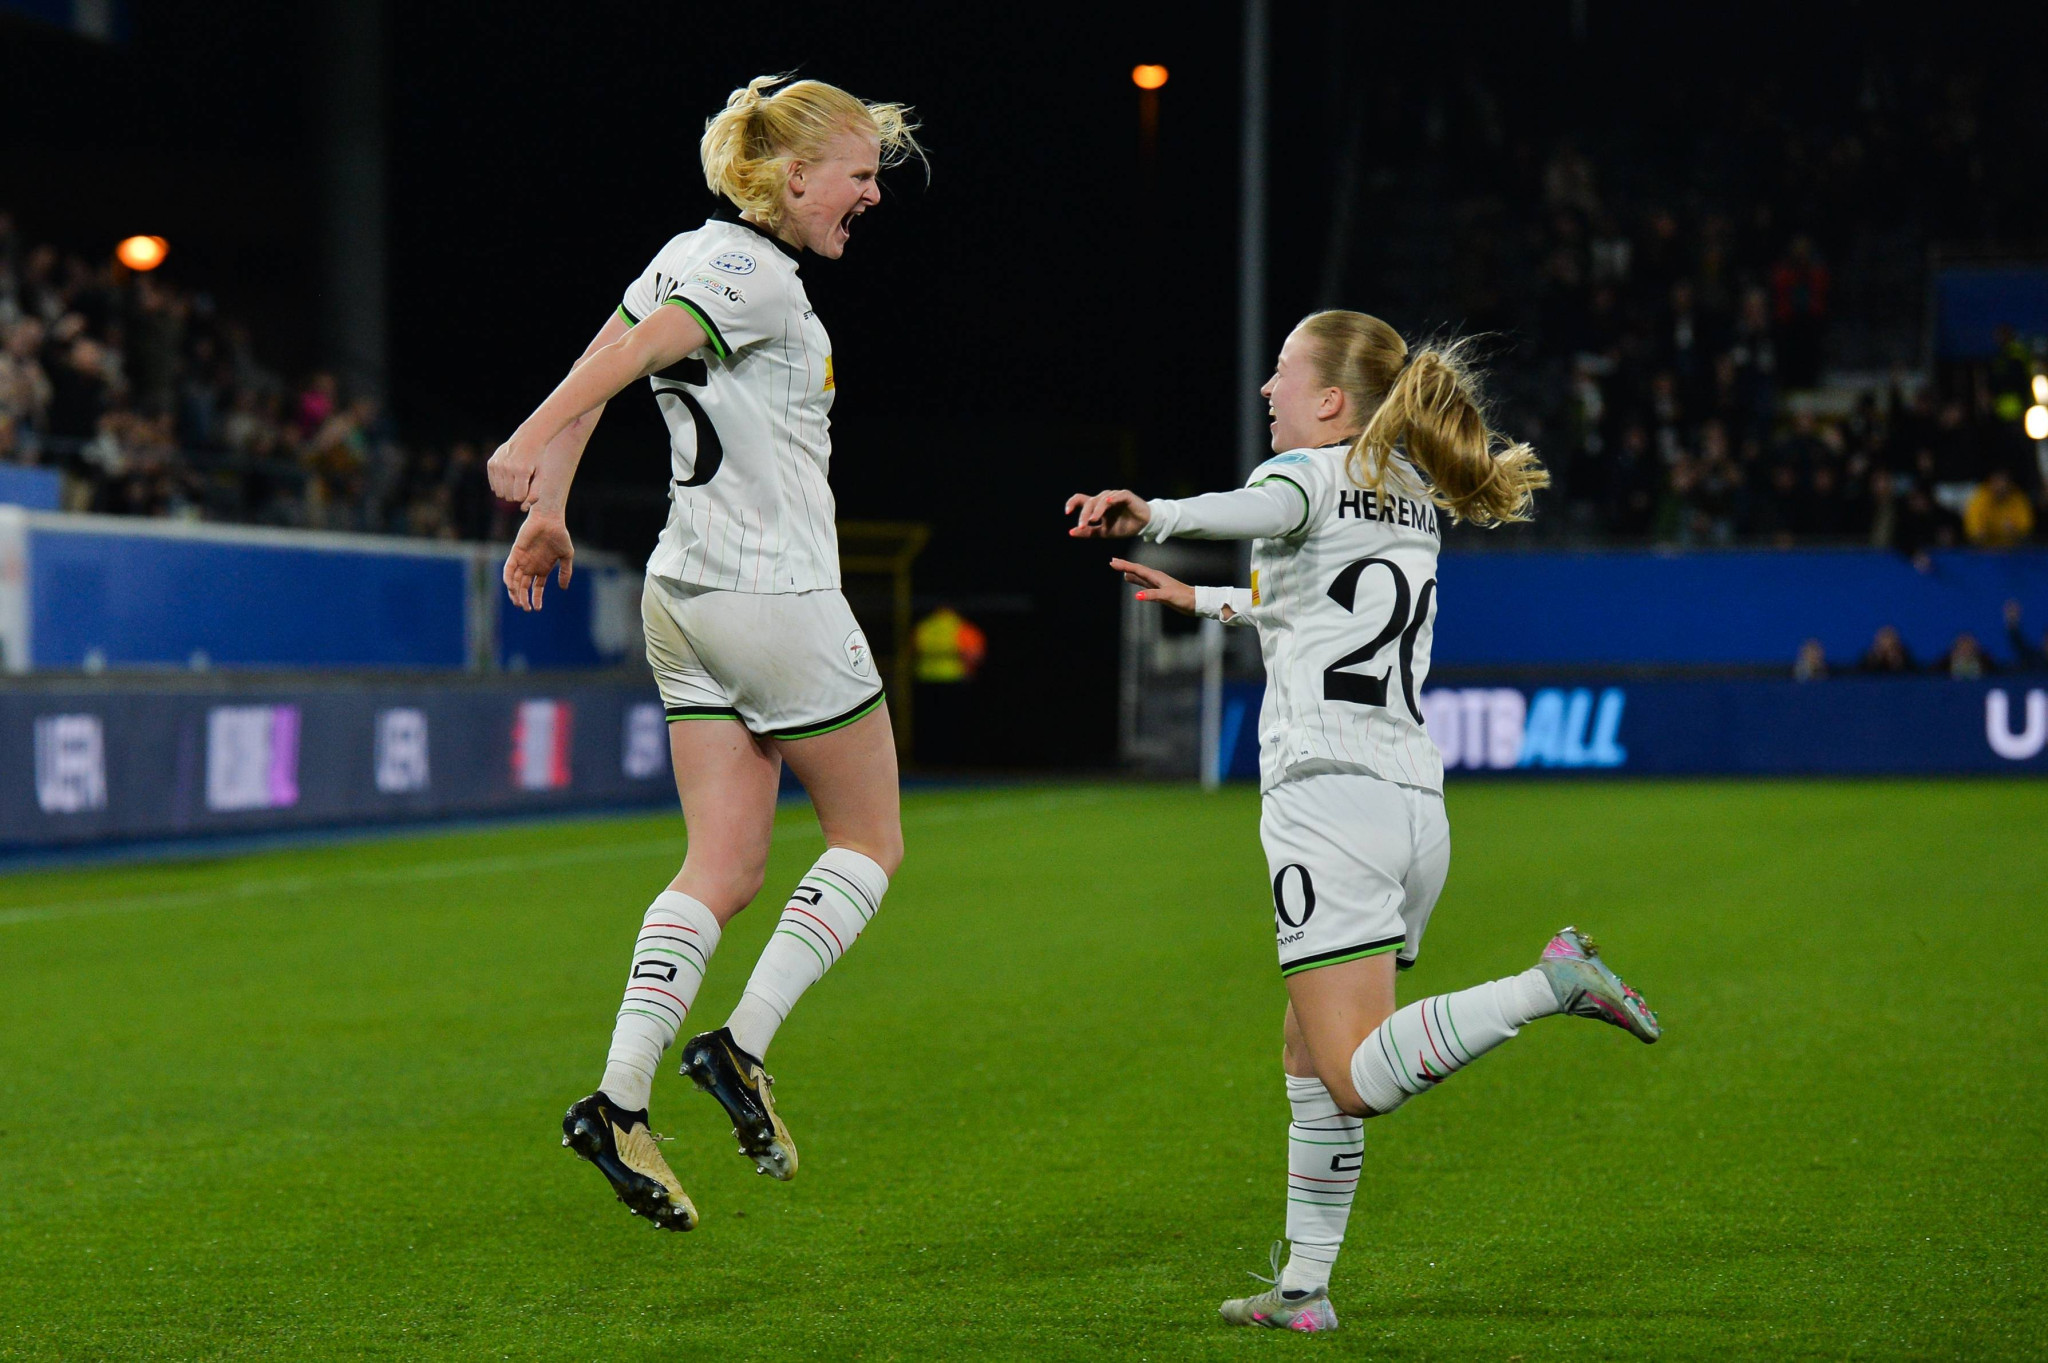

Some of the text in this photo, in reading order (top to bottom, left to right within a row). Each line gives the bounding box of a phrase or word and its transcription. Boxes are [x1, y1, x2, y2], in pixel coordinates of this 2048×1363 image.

[1338, 489, 1440, 539] HEREMA
[1420, 687, 1627, 769] OTBALL
[1274, 863, 1316, 933] 0
